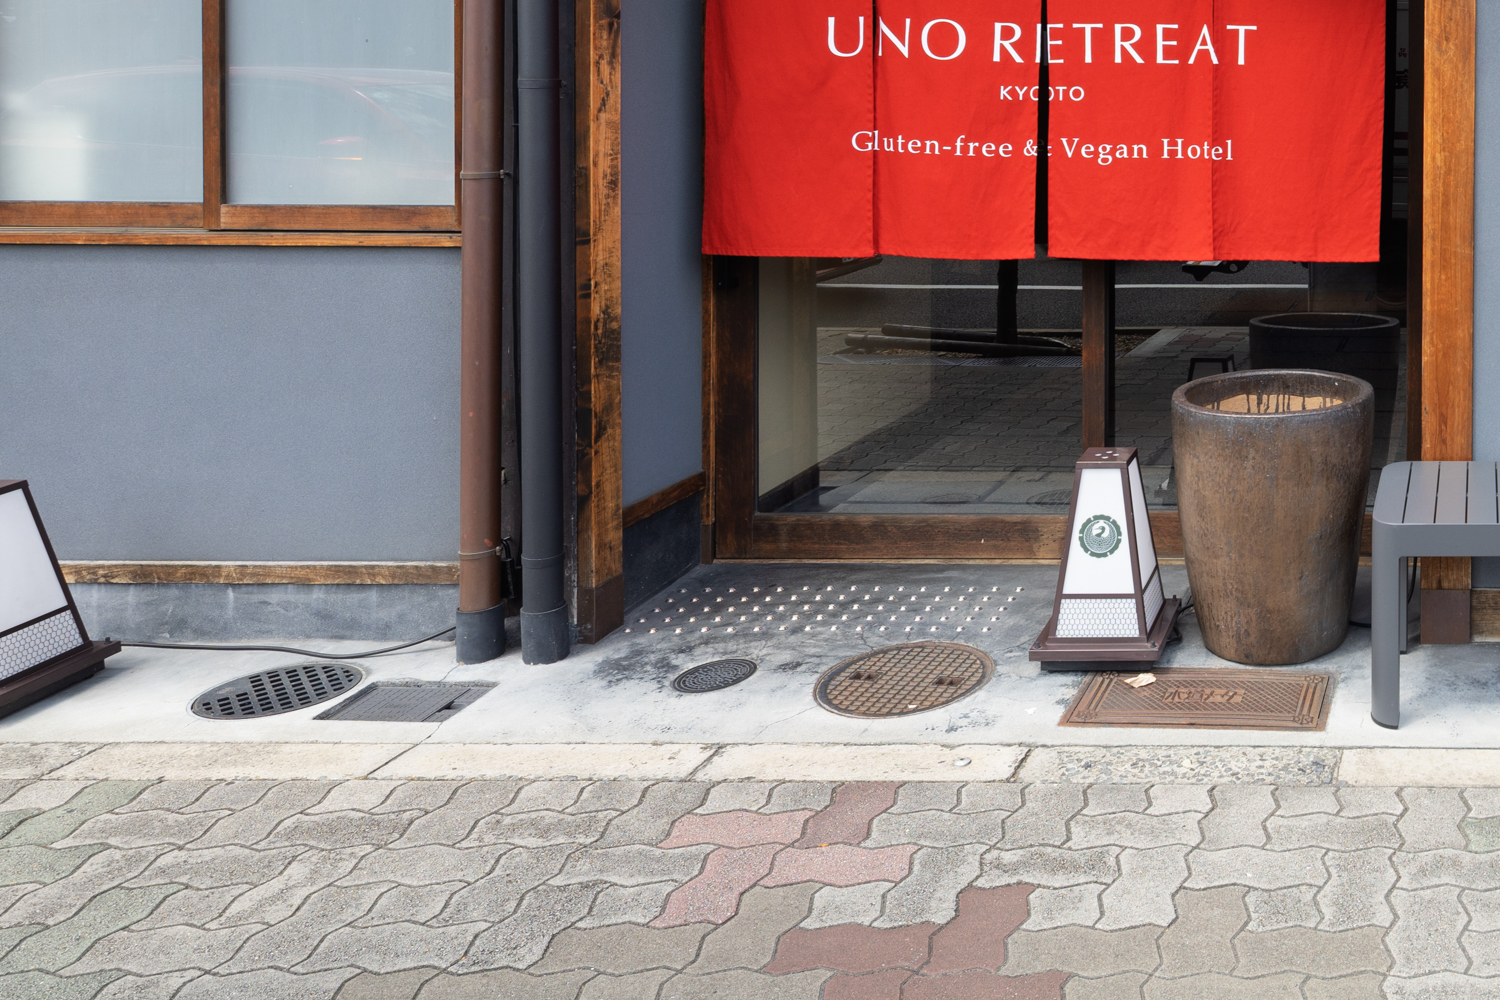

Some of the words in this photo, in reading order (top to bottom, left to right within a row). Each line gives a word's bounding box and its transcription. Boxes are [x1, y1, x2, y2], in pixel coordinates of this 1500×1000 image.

[827, 16, 967, 61] UNO
[992, 22, 1258, 66] RETREAT
[1000, 85, 1085, 102] KYOTO
[851, 130, 1013, 158] Gluten-free
[1023, 139, 1052, 157] &
[1060, 137, 1149, 166] Vegan
[1160, 138, 1234, 161] Hotel
